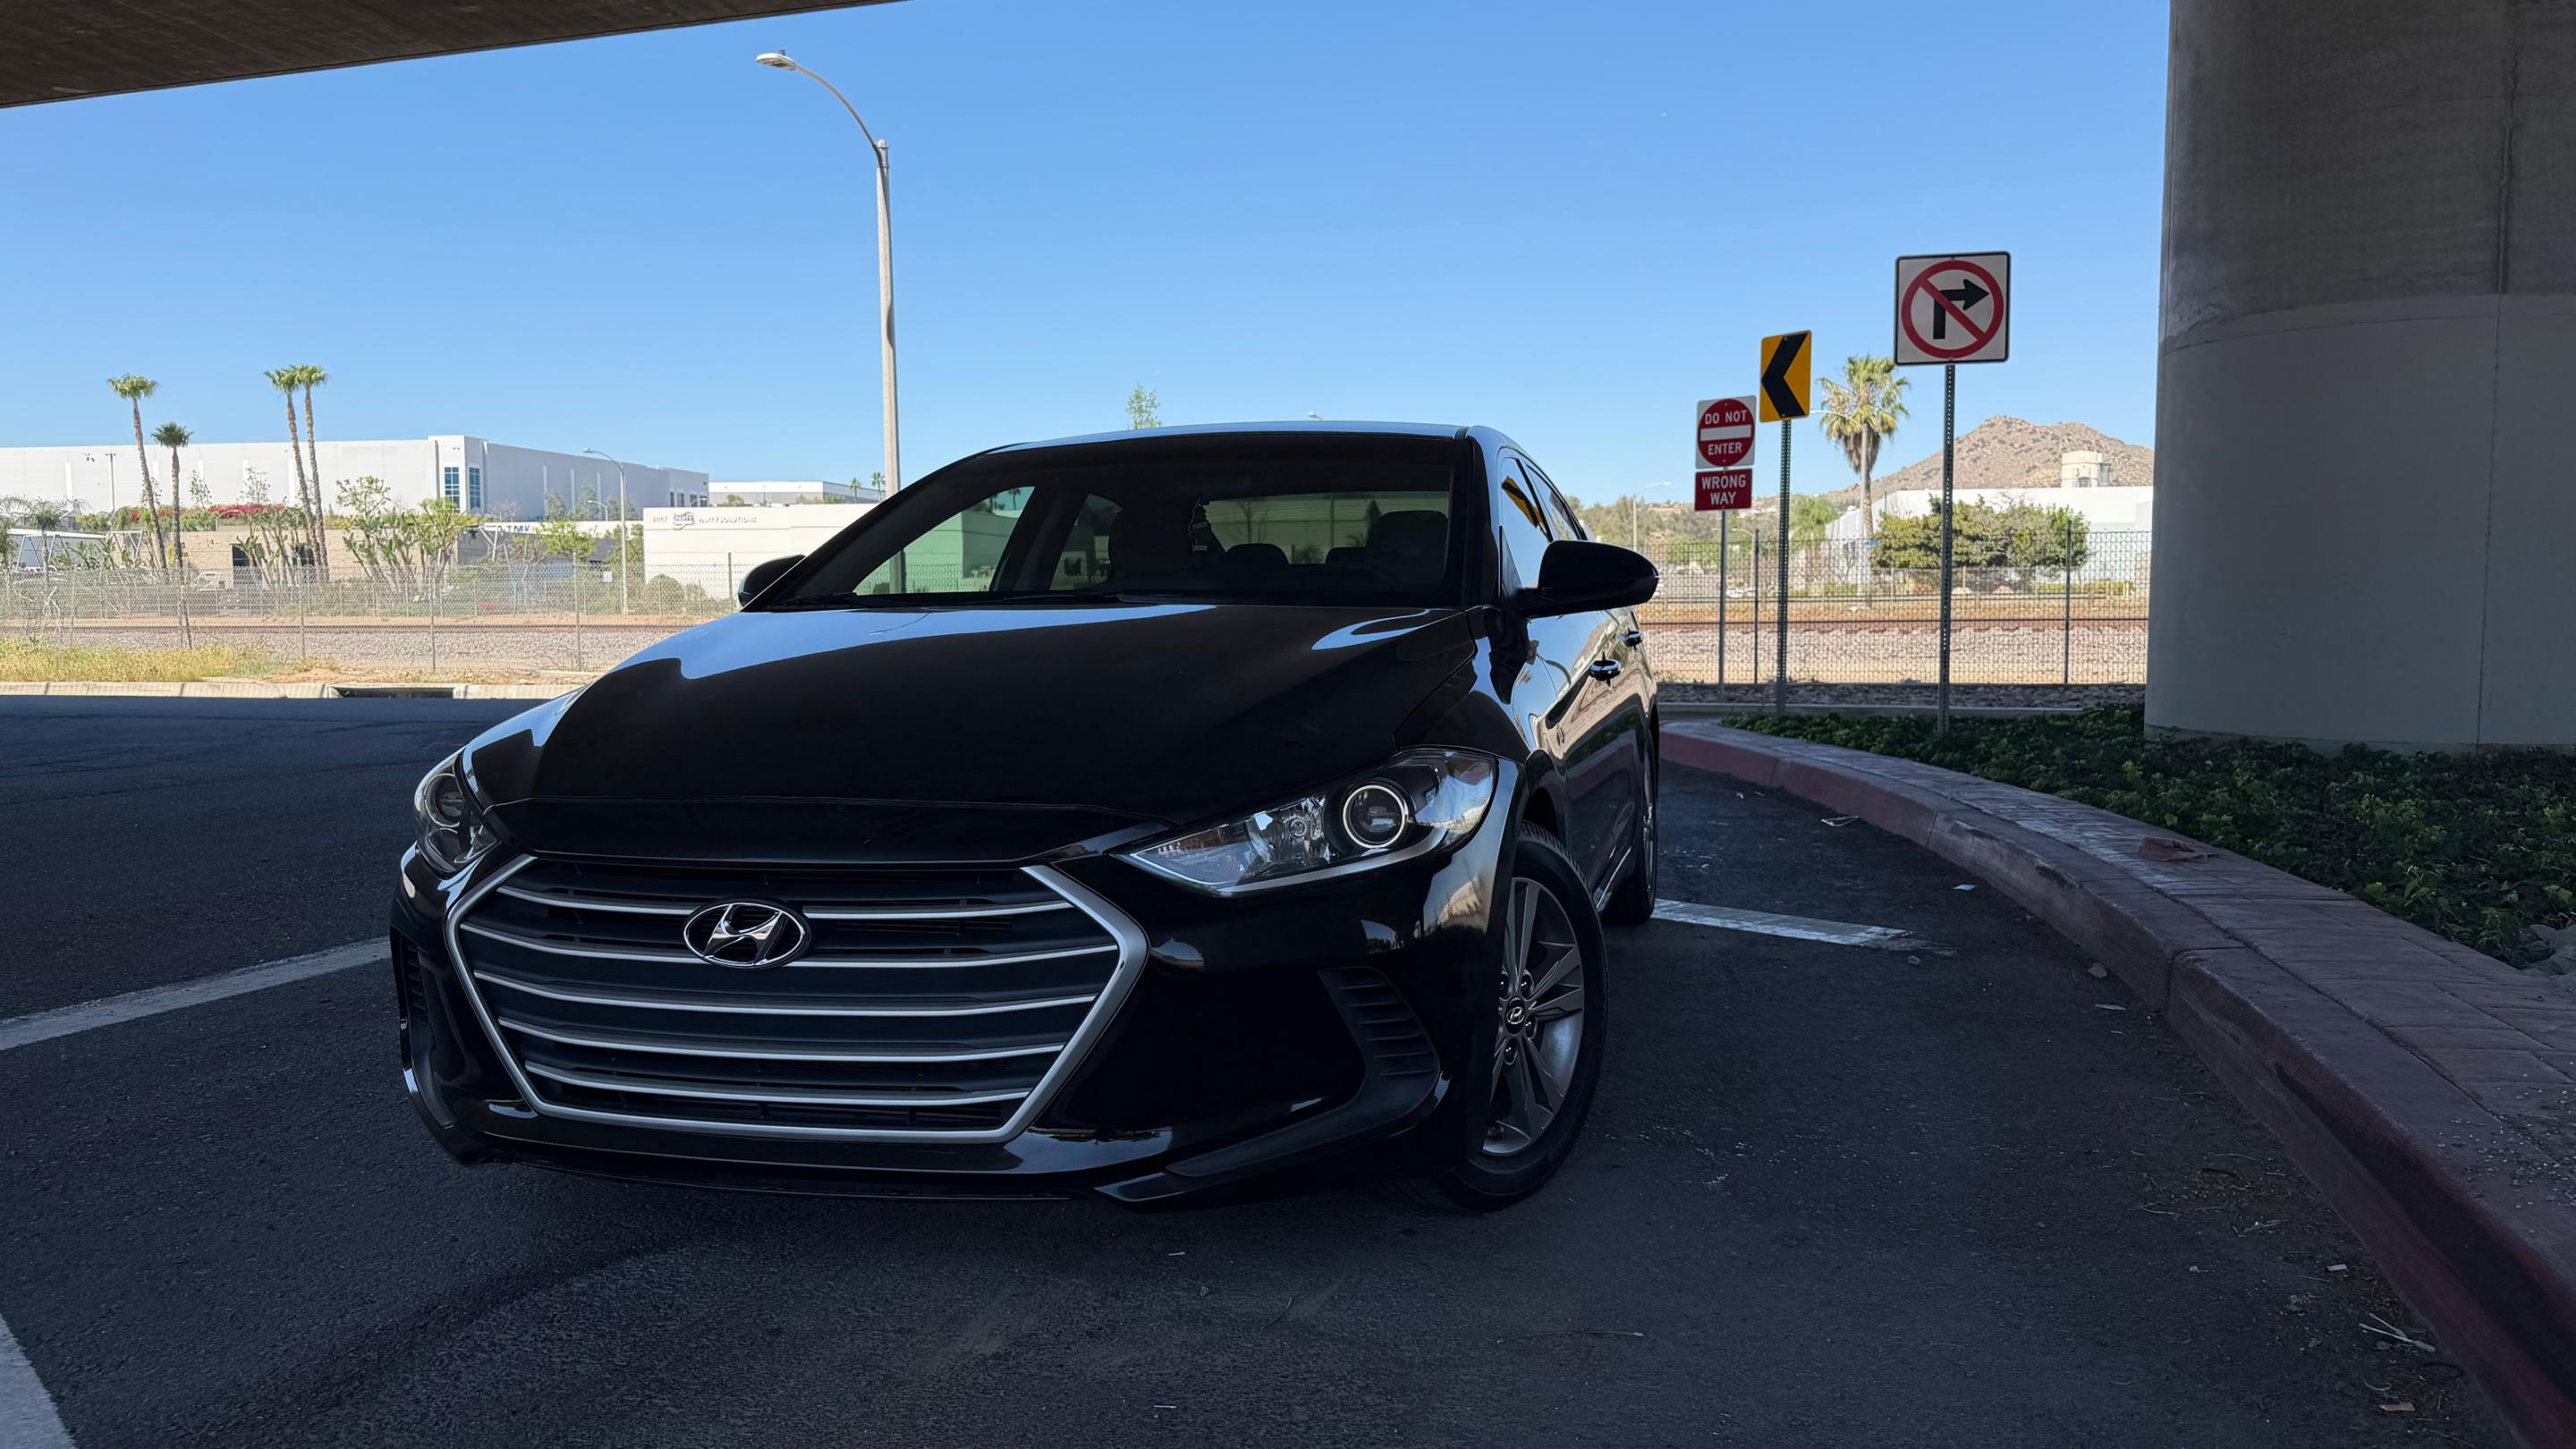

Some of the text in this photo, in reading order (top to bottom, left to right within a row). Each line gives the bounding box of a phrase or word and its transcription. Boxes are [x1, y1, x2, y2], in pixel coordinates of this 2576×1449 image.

[1705, 411, 1748, 425] DO NOT
[1707, 442, 1742, 455] ENTER
[1701, 474, 1747, 489] WRONG
[1710, 491, 1737, 505] WAY
